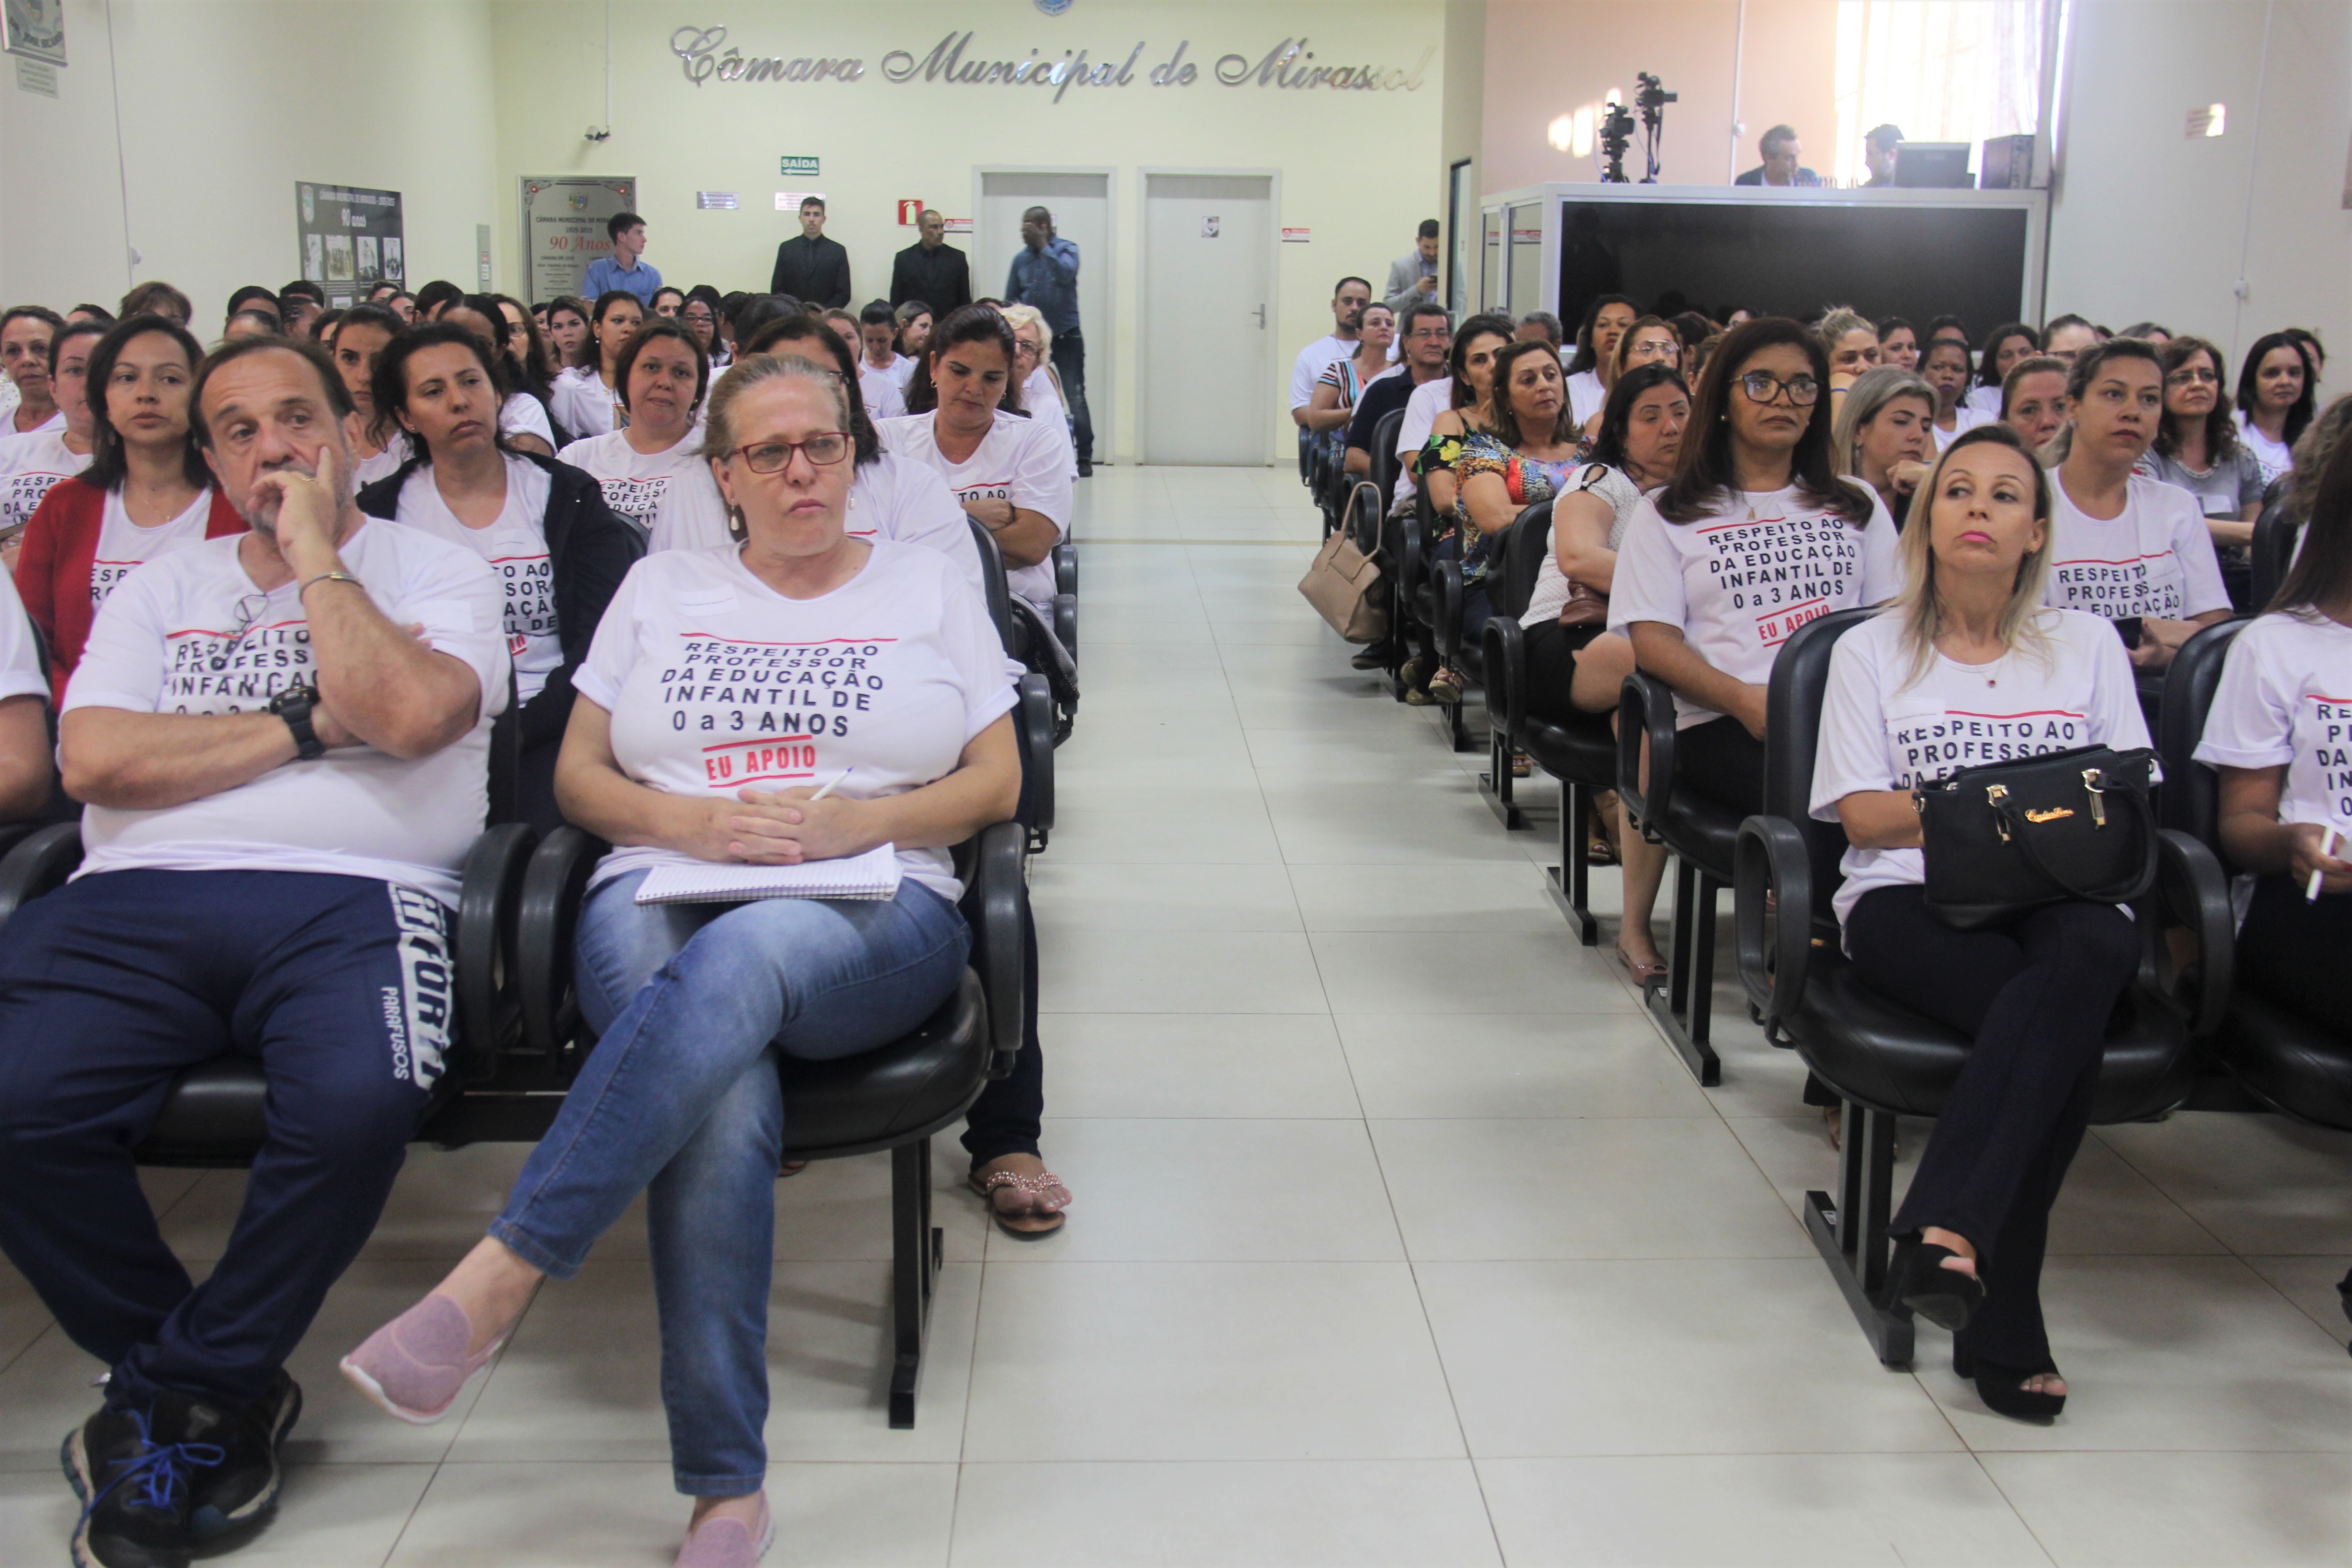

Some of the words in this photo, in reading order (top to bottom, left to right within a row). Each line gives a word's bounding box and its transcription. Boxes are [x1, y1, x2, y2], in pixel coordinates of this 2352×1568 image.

[670, 24, 864, 88] Câmara
[882, 30, 1146, 104] Municipal
[1150, 40, 1198, 87] de
[781, 158, 818, 168] SAÍDA
[550, 236, 568, 250] 90
[570, 235, 611, 252] Anos
[12, 477, 66, 487] RESP
[602, 487, 667, 502] OFESS
[4, 502, 20, 514] DA
[608, 501, 657, 512] DUCA
[1708, 520, 1813, 545] RESPEITO
[1821, 518, 1844, 529] AO
[1719, 531, 1845, 554] PROFESSOR
[1710, 557, 1736, 573] DA
[1744, 542, 1855, 567] EDUCAÇÃO
[526, 562, 549, 577] AO
[1721, 562, 1824, 589] INFANTIL
[1833, 561, 1852, 576] DE
[1734, 593, 1744, 609] 0
[1753, 595, 1763, 606] a
[1771, 588, 1781, 603] 3
[1790, 579, 1844, 601] ANOS
[2068, 581, 2174, 601] PROFESS
[531, 615, 556, 631] DE
[1758, 622, 1777, 640] EU
[685, 642, 830, 657] RESPEITO
[843, 645, 878, 656] AO
[685, 654, 866, 670] PROFESSOR
[661, 668, 695, 684] DA
[708, 669, 883, 691] EDUCAÇÃO
[664, 686, 817, 706] INFANTIL
[833, 691, 870, 711] DE
[672, 710, 686, 731] 0
[700, 714, 715, 730] a
[730, 710, 744, 731] 3
[758, 711, 848, 737] ANOS
[1897, 720, 2033, 745] RESPEITO
[2045, 720, 2074, 740] AO
[2328, 724, 2352, 743] P
[706, 755, 732, 781] EU
[746, 745, 815, 774] APOIO
[2316, 749, 2347, 766] DA
[1936, 765, 1967, 780] E
[381, 986, 409, 1081] PARAFUSOS
